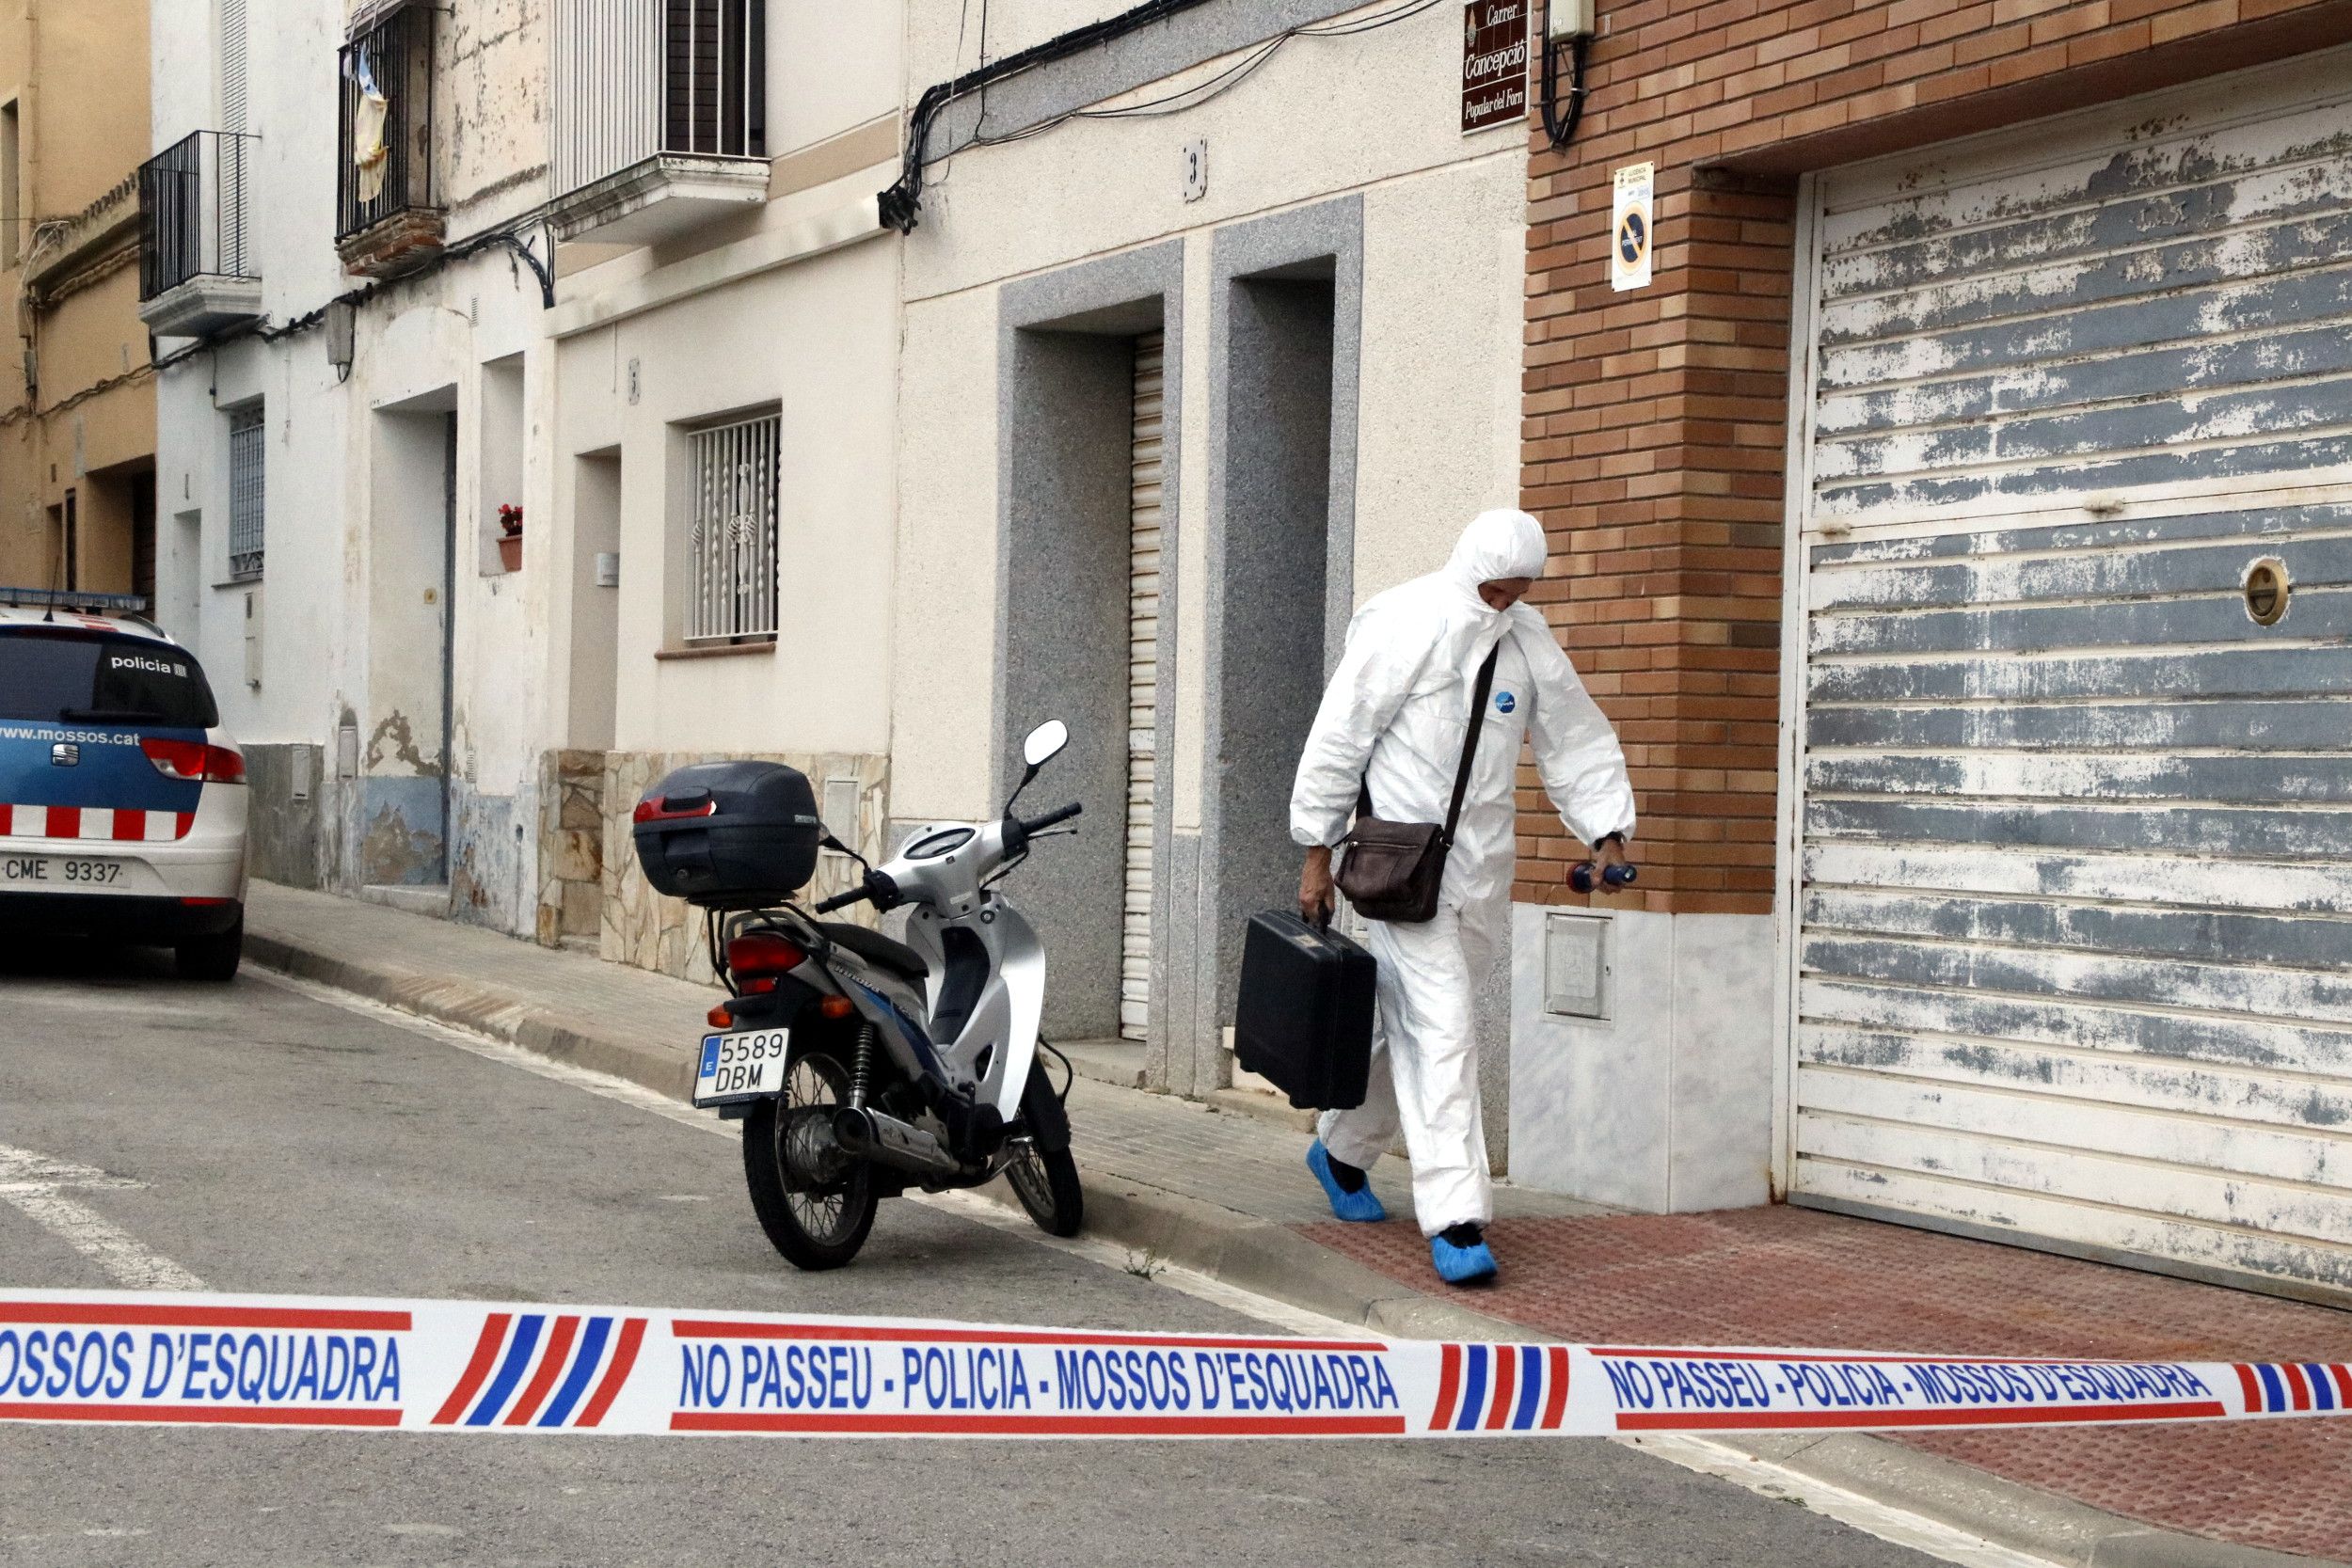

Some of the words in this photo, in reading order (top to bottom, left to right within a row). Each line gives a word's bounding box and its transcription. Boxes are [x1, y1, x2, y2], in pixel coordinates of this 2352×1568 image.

[1486, 4, 1518, 26] Carrer
[1465, 39, 1525, 79] Concepció
[1465, 96, 1494, 122] Popular
[1493, 89, 1505, 111] del
[1505, 87, 1523, 108] Forn
[111, 657, 171, 673] policia
[0, 727, 140, 746] ww.mossos.cat
[6, 860, 48, 879] CME
[65, 862, 120, 883] 9337
[721, 1034, 784, 1063] 5589
[706, 1062, 714, 1070] E
[716, 1063, 764, 1092] DBM
[142, 1332, 401, 1404] D'ESQUADRA
[680, 1344, 732, 1408] NO
[740, 1344, 872, 1409] PASSEU
[902, 1347, 1031, 1410] POLICIA
[1055, 1349, 1191, 1411] MOSSOS
[1196, 1352, 1400, 1414] D'ESQUADRA
[1601, 1360, 1654, 1408] NO
[1648, 1361, 1771, 1408] PASSEU
[1785, 1363, 1904, 1407] POLICIA
[1903, 1364, 2036, 1404] MOSSOS
[2025, 1363, 2213, 1402] D'ESQUADRA
